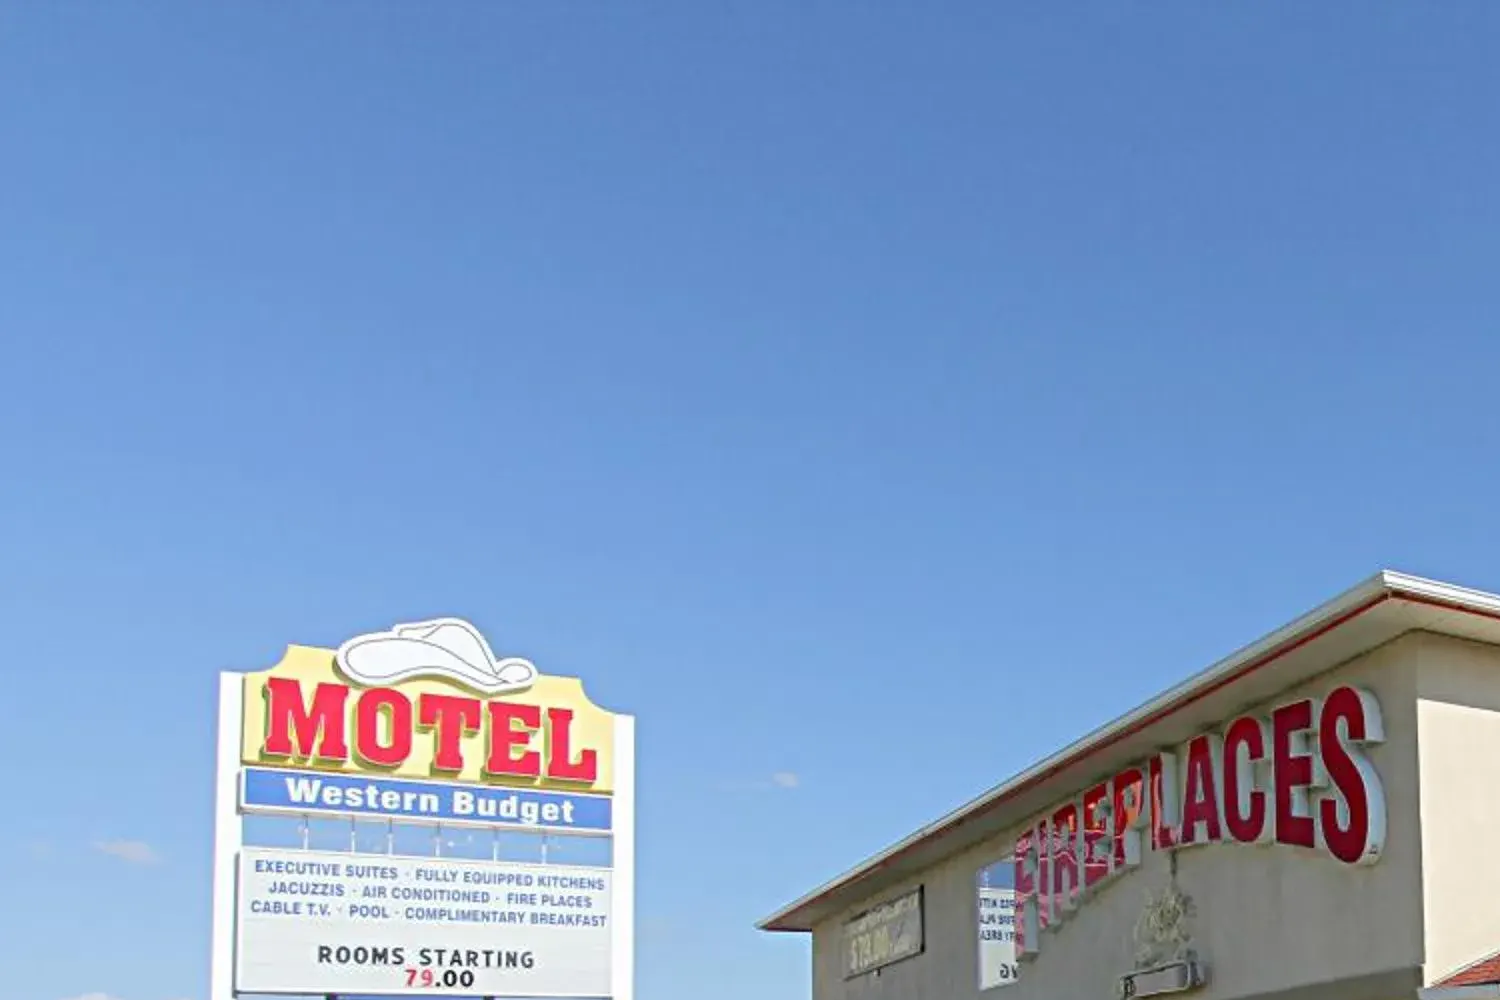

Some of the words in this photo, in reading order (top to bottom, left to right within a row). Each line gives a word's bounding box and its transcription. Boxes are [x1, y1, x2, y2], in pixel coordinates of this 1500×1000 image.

[264, 676, 598, 783] MOTEL
[285, 777, 440, 813] Western
[453, 790, 575, 824] Budget
[1015, 686, 1370, 957] FIREPLACES
[255, 859, 341, 878] EXECUTIVE
[345, 864, 399, 880] SUITES
[415, 868, 459, 883] FULLY
[463, 870, 533, 888] EQUIPPED
[537, 874, 605, 892] KITCHENS
[268, 881, 346, 898] JACUZZIS
[362, 885, 387, 899] AIR
[391, 886, 491, 905] CONDITIONED
[507, 892, 538, 906] FIRE
[541, 893, 593, 909] PLACES
[250, 900, 302, 916] CABLE
[349, 904, 390, 920] POOL
[405, 906, 526, 926] COMPLIMENTARY
[529, 910, 607, 929] BREAKFAST
[318, 945, 405, 966] ROOMS
[419, 949, 535, 970] STARTING
[404, 968, 475, 988] 79.00
